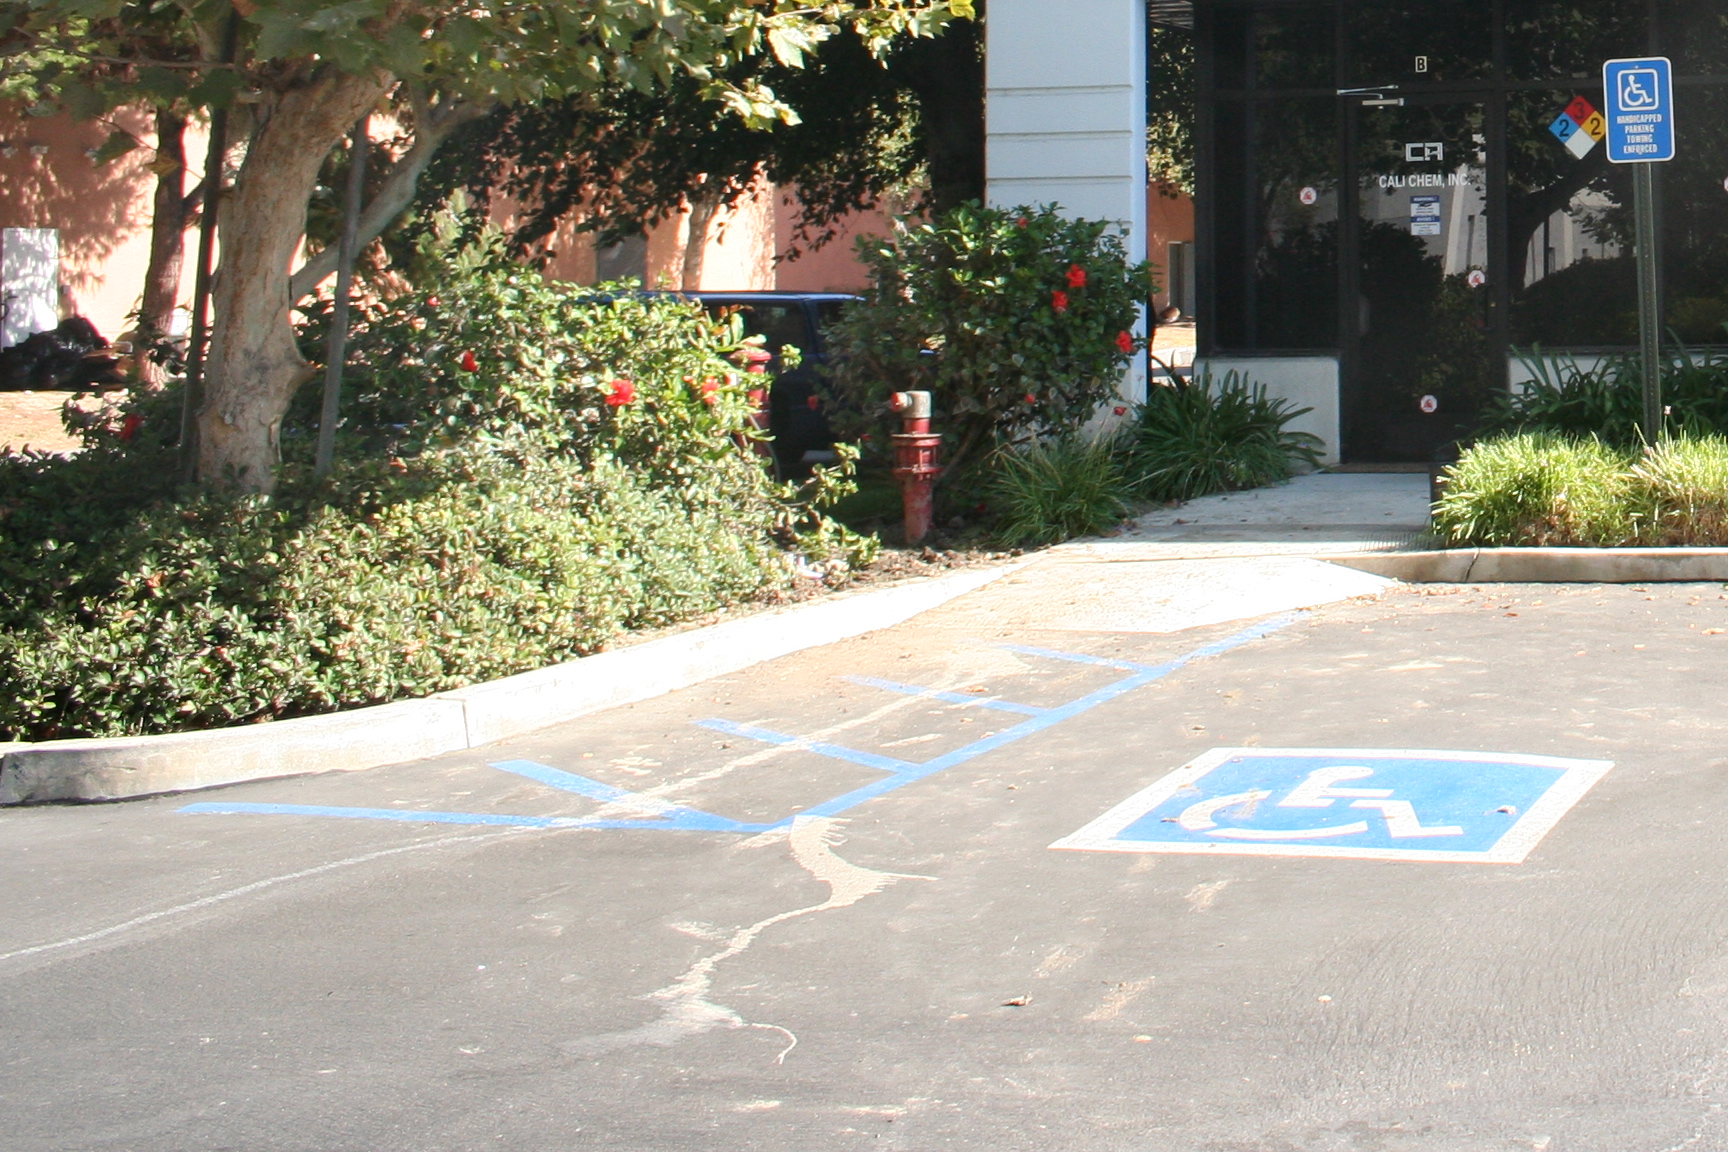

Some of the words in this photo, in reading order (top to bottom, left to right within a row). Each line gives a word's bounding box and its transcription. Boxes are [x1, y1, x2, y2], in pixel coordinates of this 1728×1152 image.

[1417, 57, 1426, 71] B
[1573, 102, 1585, 120] 3
[1616, 113, 1662, 124] HANDICAPPED
[1559, 118, 1570, 137] 2
[1591, 117, 1601, 136] 2
[1625, 124, 1655, 133] PARKING
[1627, 134, 1653, 143] TOWING
[1623, 144, 1658, 154] ENFORCED
[1379, 174, 1406, 188] CALI
[1408, 173, 1445, 188] CHEM,
[1448, 173, 1471, 186] INC.
